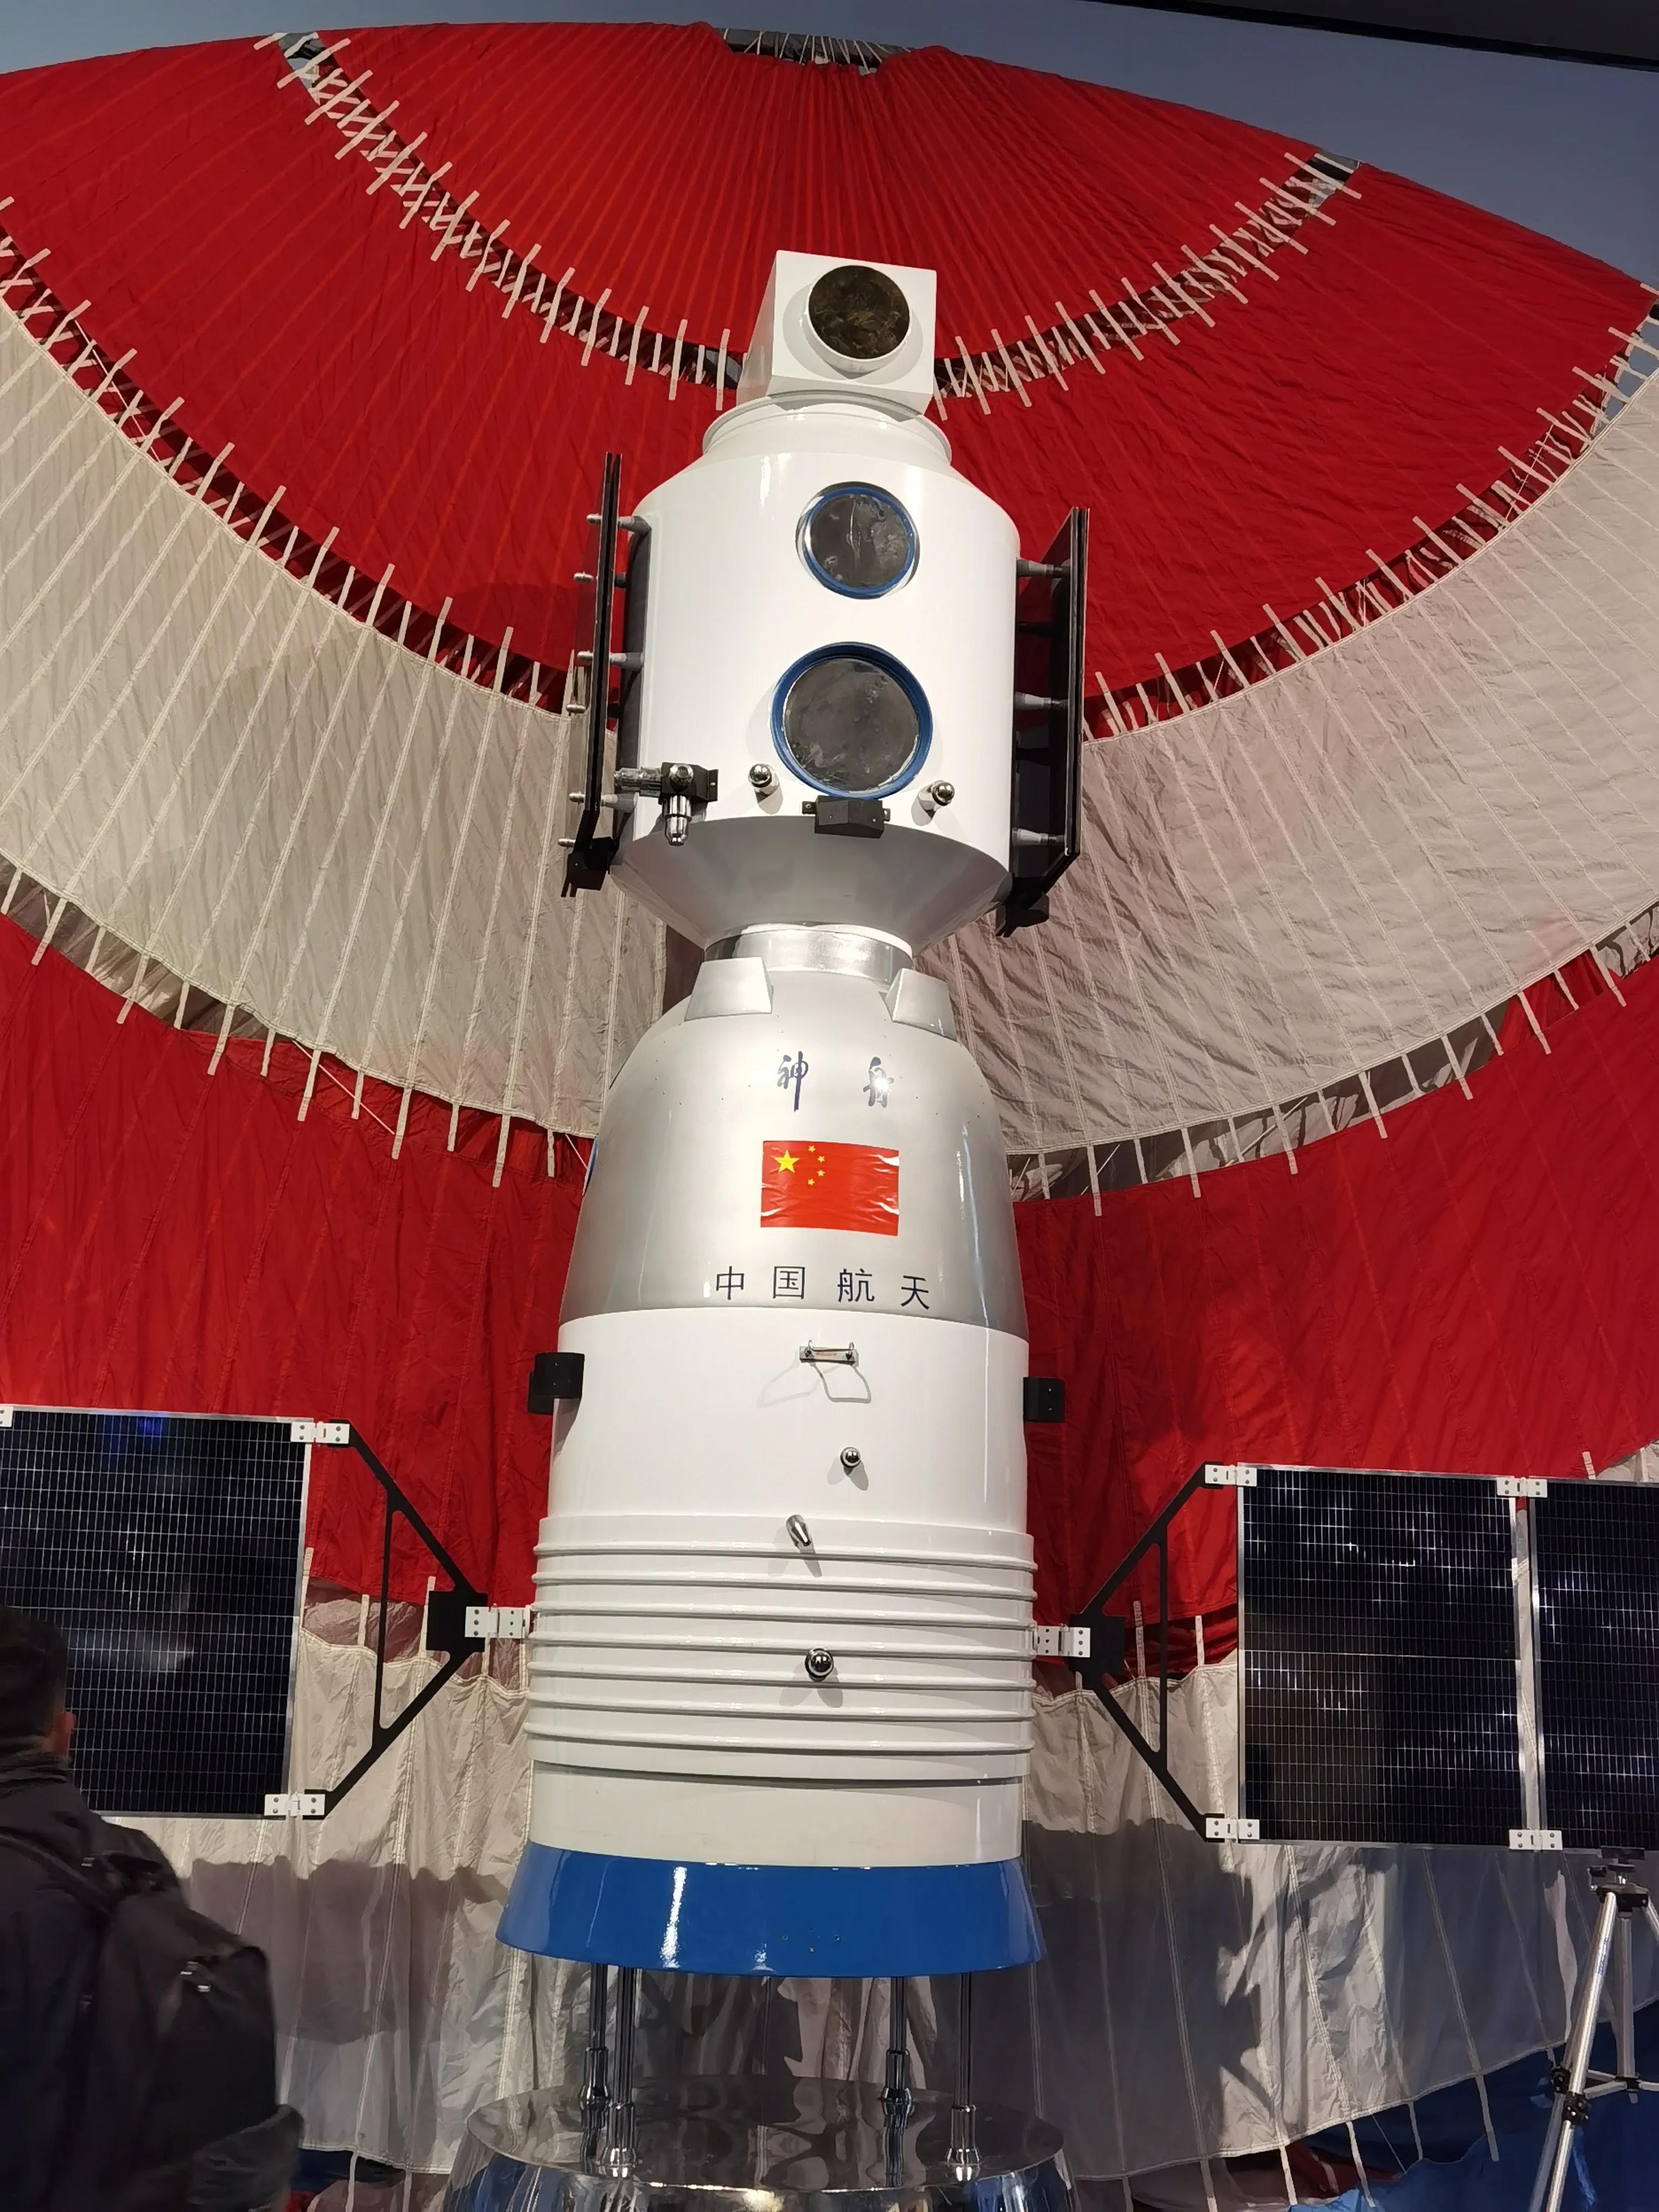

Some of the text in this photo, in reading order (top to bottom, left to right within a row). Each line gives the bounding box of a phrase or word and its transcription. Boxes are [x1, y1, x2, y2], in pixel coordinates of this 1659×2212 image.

[777, 1051, 894, 1112] 神舟
[716, 1265, 930, 1310] 中国航天
